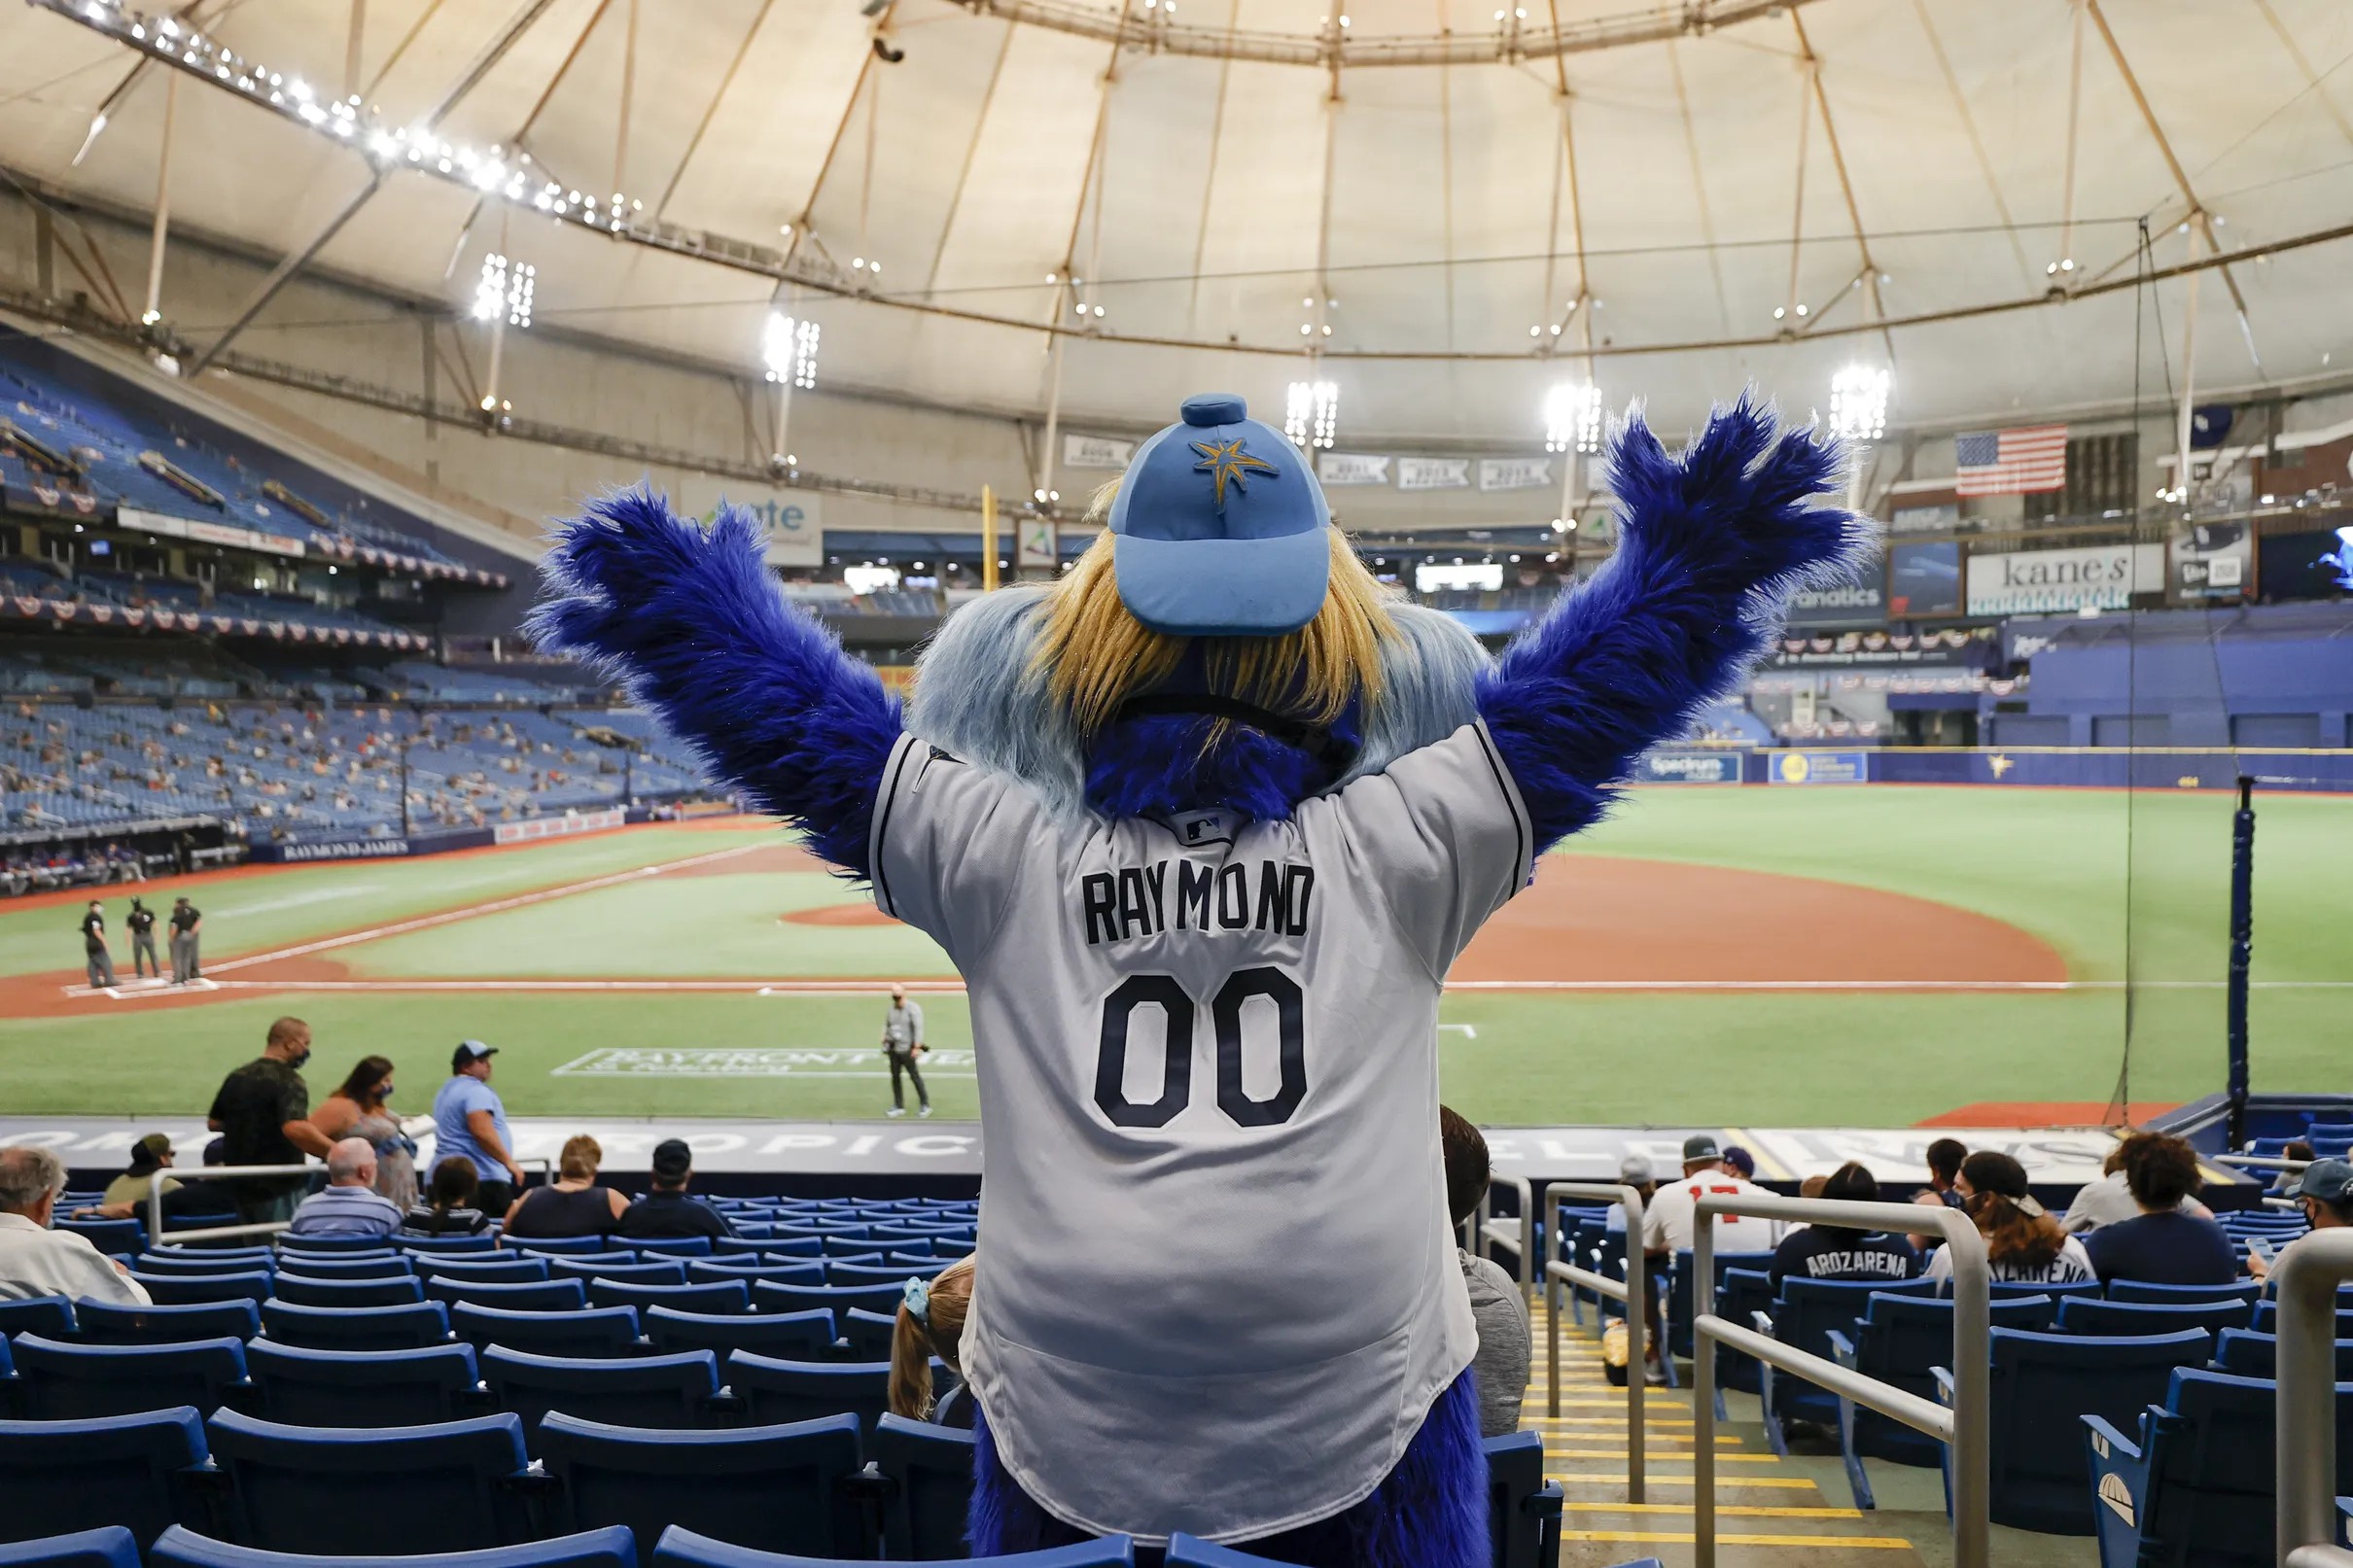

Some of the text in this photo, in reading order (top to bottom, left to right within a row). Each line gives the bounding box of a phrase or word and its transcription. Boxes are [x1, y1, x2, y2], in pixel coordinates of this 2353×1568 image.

[2003, 556, 2128, 587] kane's
[1081, 859, 1315, 945] RAYMOND
[1094, 965, 1308, 1128] 00
[512, 1132, 982, 1157] TROPIC
[1806, 1250, 1908, 1279] AROZARENA
